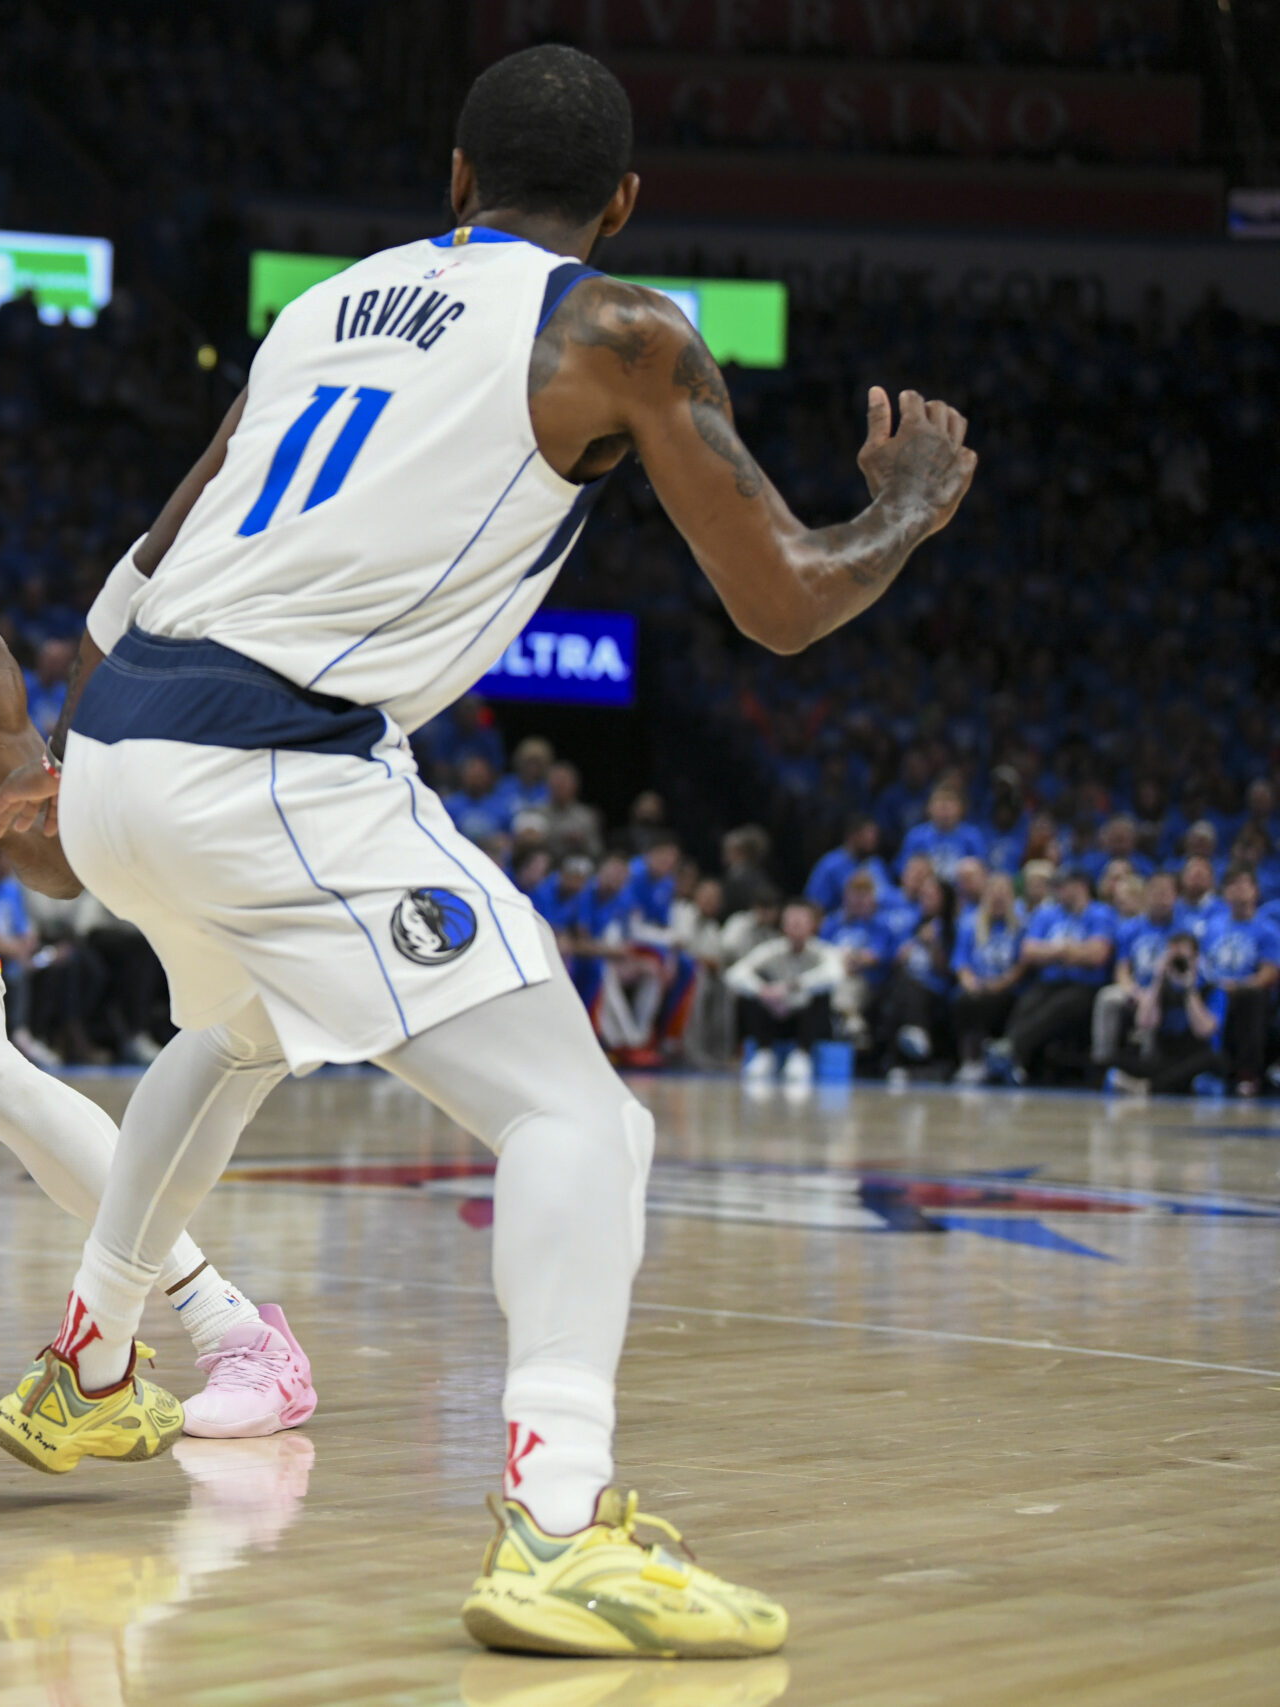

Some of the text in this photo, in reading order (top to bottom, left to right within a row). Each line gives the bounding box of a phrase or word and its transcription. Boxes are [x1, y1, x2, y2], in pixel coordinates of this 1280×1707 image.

[670, 76, 1072, 148] CASINO
[334, 285, 466, 352] IRVING
[234, 383, 396, 538] 11
